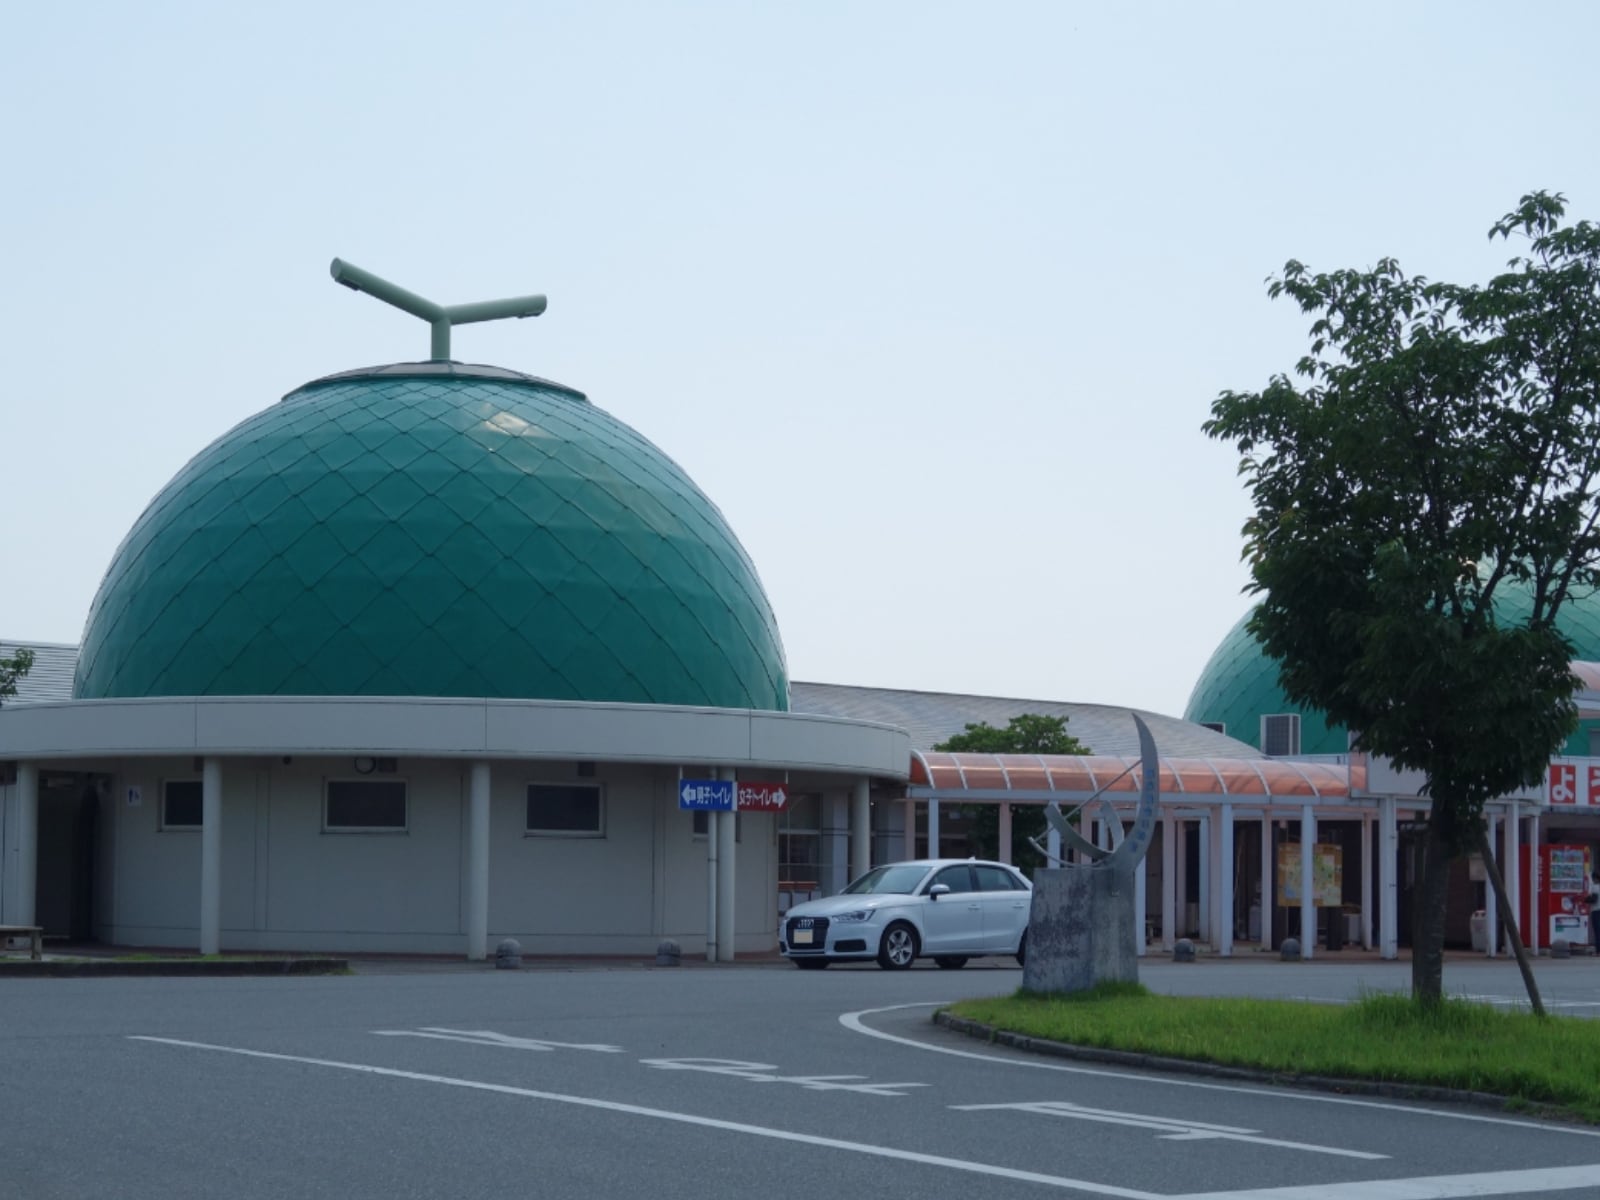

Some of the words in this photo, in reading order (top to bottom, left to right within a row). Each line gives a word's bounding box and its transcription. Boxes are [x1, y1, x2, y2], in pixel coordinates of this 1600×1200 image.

[697, 785, 731, 804] 男子トイレ
[738, 787, 772, 806] 女子トイレ
